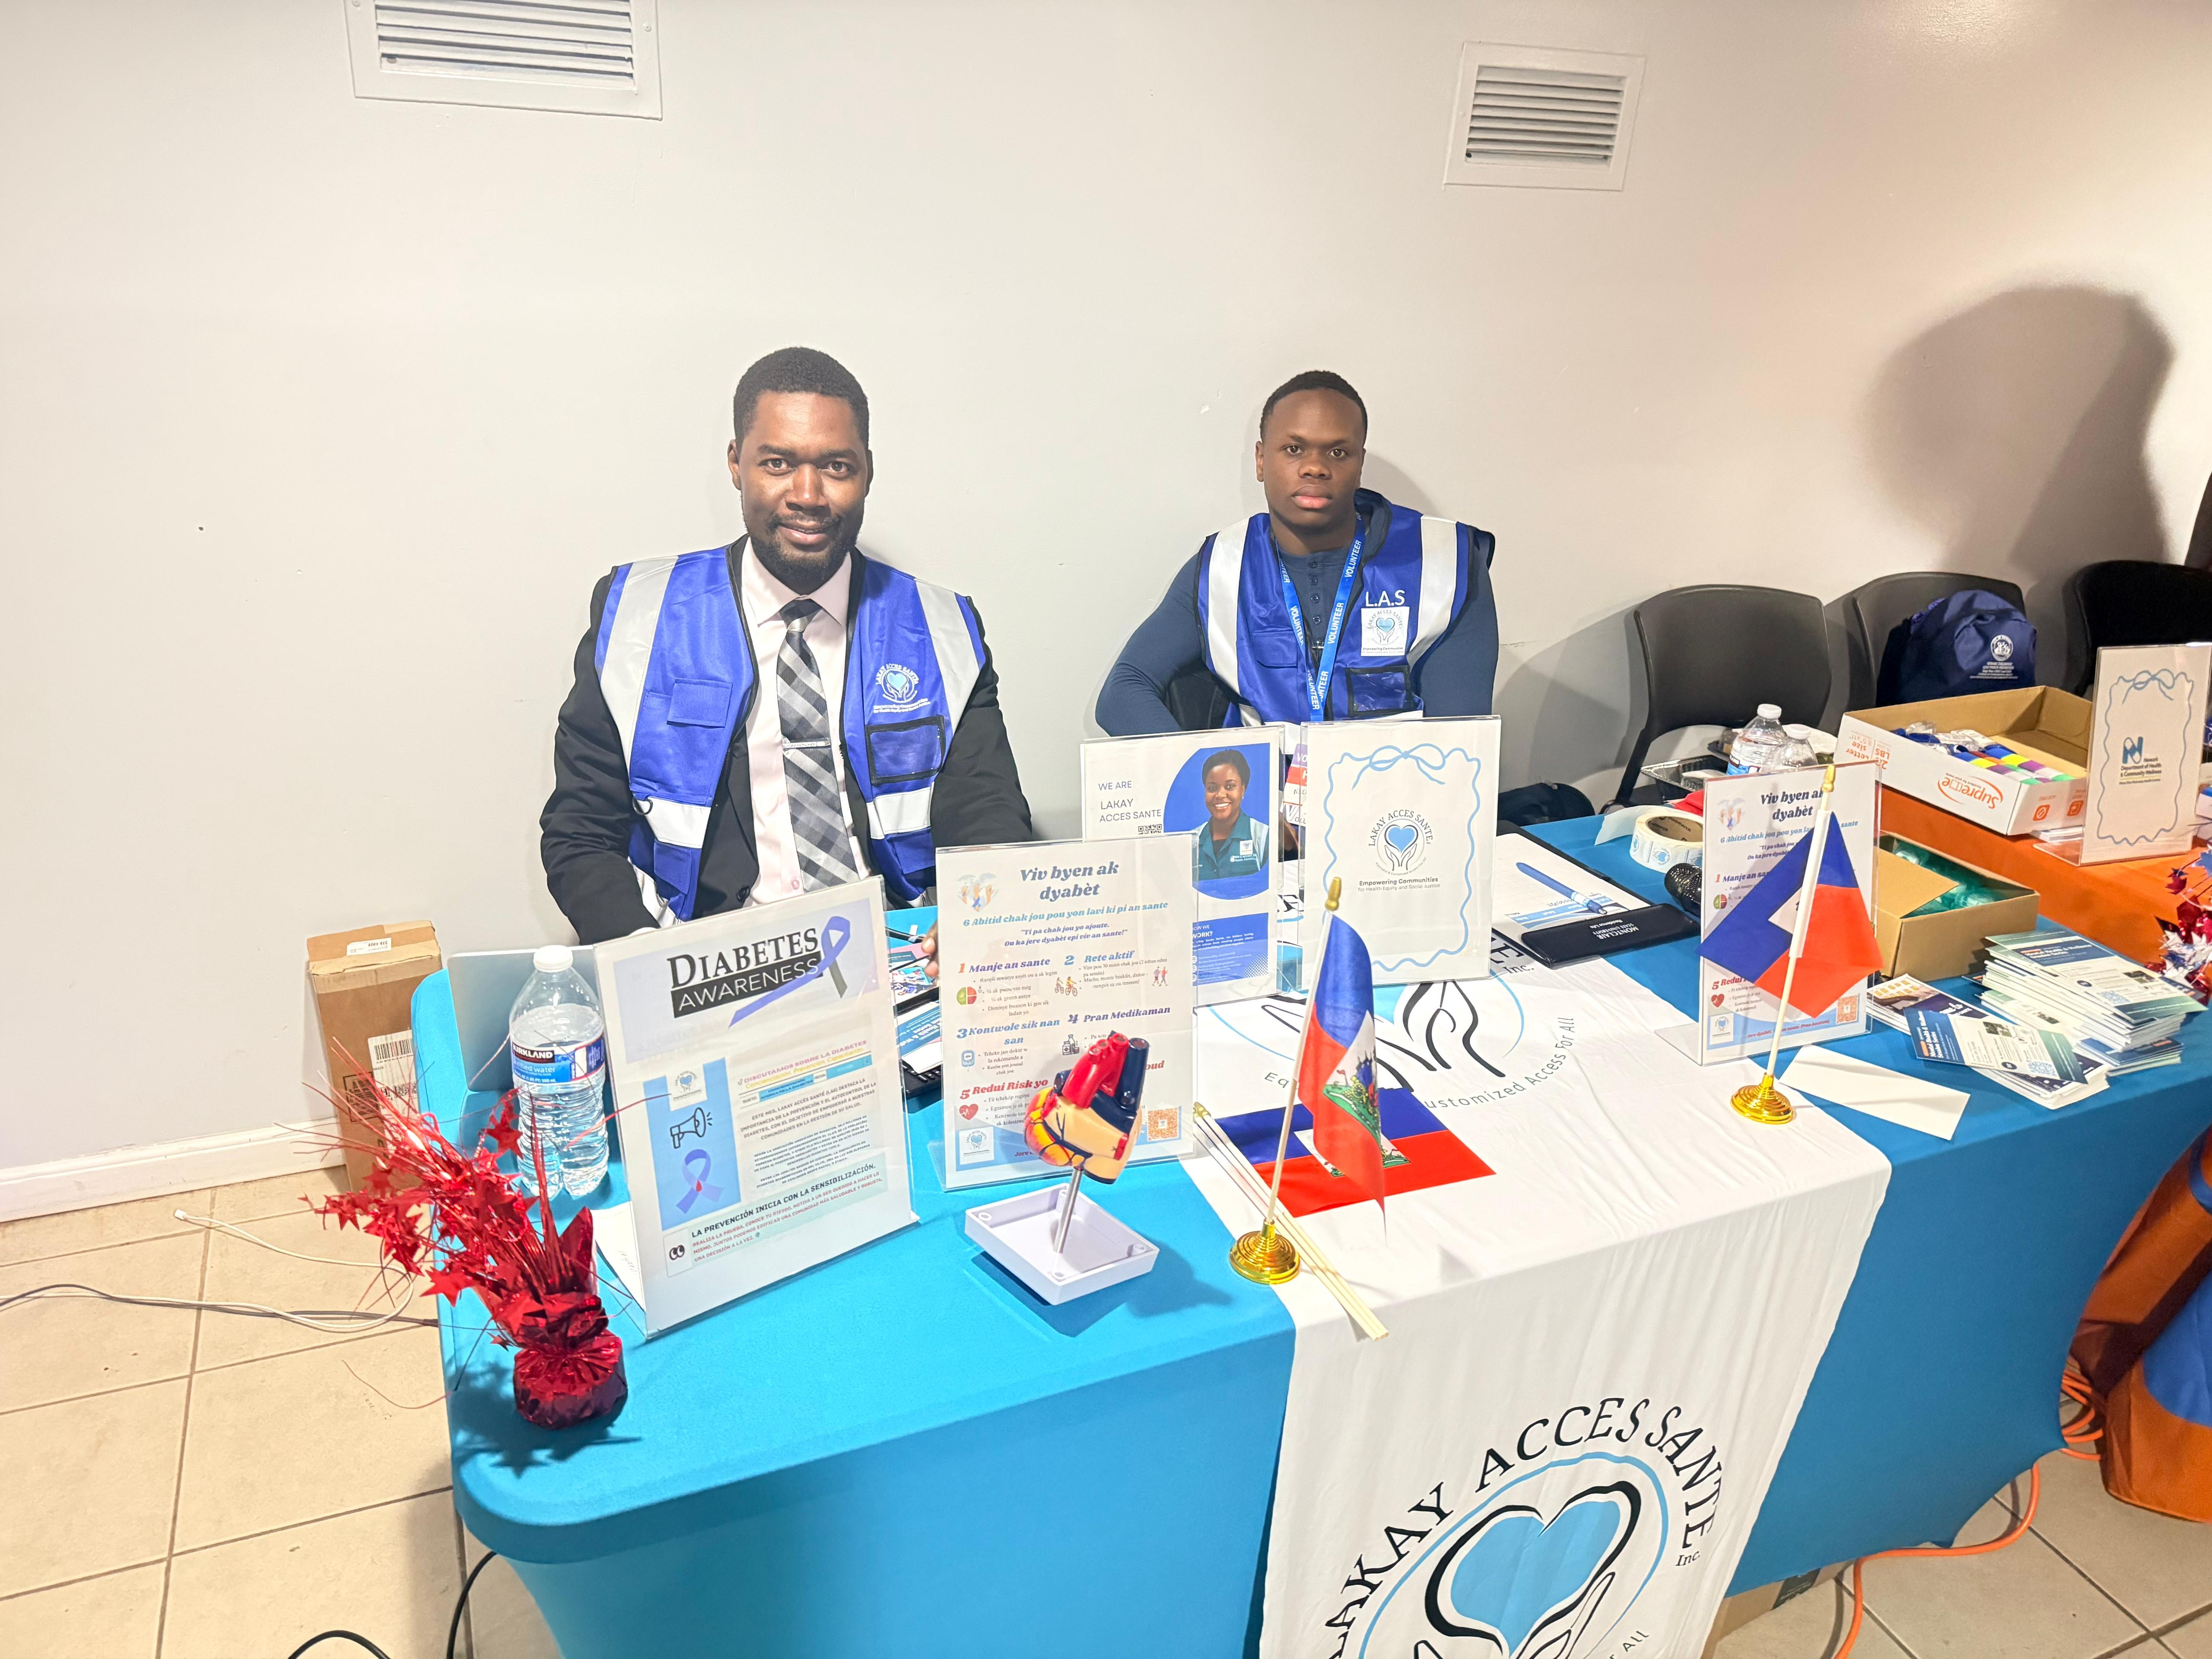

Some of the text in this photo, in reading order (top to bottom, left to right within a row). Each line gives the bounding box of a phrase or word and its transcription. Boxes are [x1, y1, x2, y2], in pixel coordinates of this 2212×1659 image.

[1344, 540, 1361, 578] VOLUNTEER
[1366, 590, 1405, 607] L.A.S
[1290, 606, 1303, 646] VOLUNTEER
[1327, 602, 1344, 644] VOLUNTEER
[1875, 748, 1890, 760] LBS
[1098, 781, 1131, 791] WE ARE
[1101, 798, 1133, 809] LAKAY
[1761, 791, 1778, 805] Viv
[1780, 791, 1808, 804] byen
[1100, 809, 1161, 822] ACCES SANTE
[1773, 806, 1814, 821] dyabèt
[1369, 810, 1433, 846] LAKAY ACCES SANTE
[1748, 831, 1764, 840] chak
[1764, 831, 1775, 839] jou
[1020, 861, 1119, 882] Viv byen ak
[1723, 873, 1746, 883] Manje
[1039, 883, 1100, 902] dyabèt
[972, 915, 1001, 926] Abitid
[1004, 913, 1028, 923] chak
[1028, 912, 1045, 922] jou
[1046, 911, 1065, 920] pou
[1066, 909, 1085, 918] yon
[1087, 906, 1105, 915] lavi
[1106, 905, 1116, 913] ki
[1117, 904, 1126, 914] pi
[1142, 901, 1168, 910] sante
[1043, 925, 1061, 934] chak
[1596, 926, 1639, 939] MONTCLAIR
[1041, 935, 1066, 944] dyabèt
[667, 928, 819, 989] DIABETES
[959, 963, 965, 973] 1
[969, 963, 1003, 973] Manje
[1020, 958, 1050, 967] sante
[1065, 950, 1135, 966] 2 Rete aktif
[1502, 965, 1534, 973] Inc.
[679, 958, 819, 1011] AWARENESS
[1712, 981, 1719, 990] 5
[1068, 1007, 1170, 1023] 4 Pran Medikaman
[957, 1028, 968, 1039] 3
[969, 1023, 1020, 1036] Kontwole
[1021, 1020, 1038, 1029] sik
[513, 1045, 553, 1058] KIRKLAND
[744, 1063, 793, 1083] DISCUTAMOS
[795, 1055, 819, 1067] SOBRE
[832, 1039, 867, 1055] DIABETES
[1424, 1017, 1575, 1109] ustomized Access For All
[778, 1103, 792, 1112] LAKAY
[839, 1080, 858, 1090] DESTACA
[960, 1080, 1048, 1099] 5 Redui Risk yo
[692, 1229, 702, 1238] LA
[704, 1208, 753, 1233] PREVENCIÓN
[755, 1198, 782, 1214] INICIA
[783, 1192, 798, 1203] CON
[800, 1188, 809, 1196] LA
[1475, 1398, 1649, 1493] ACCES
[1644, 1406, 1722, 1549] SANTE
[1622, 1630, 1649, 1652] All
